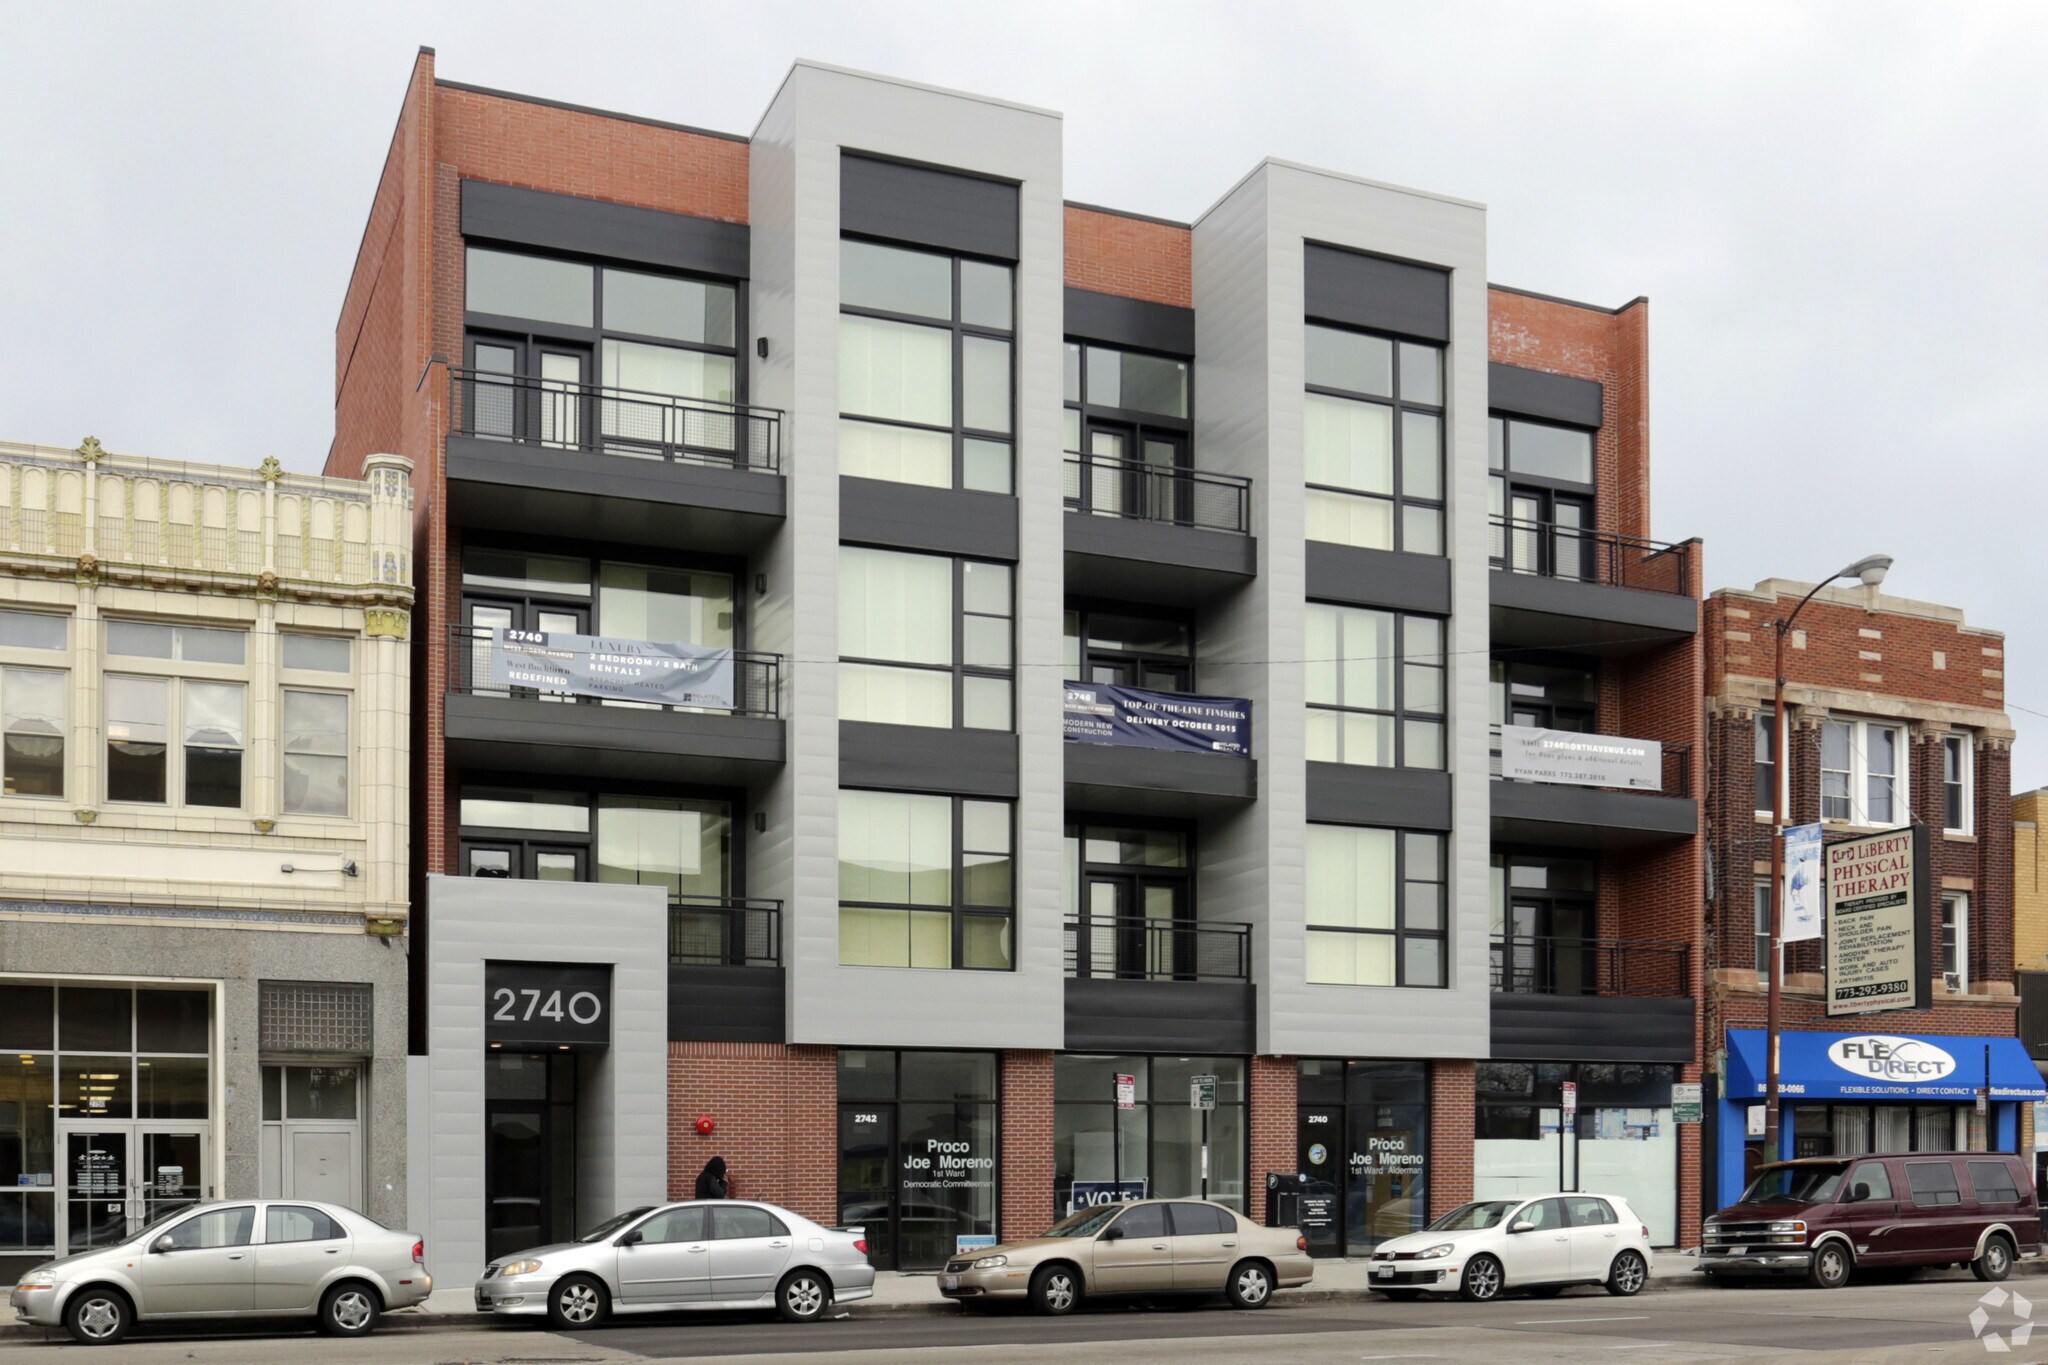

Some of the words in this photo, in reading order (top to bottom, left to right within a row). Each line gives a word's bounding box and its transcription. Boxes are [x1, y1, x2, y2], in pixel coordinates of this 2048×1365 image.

[509, 630, 543, 642] 2740
[547, 651, 574, 659] AVENUE
[600, 654, 652, 666] BEDROOM
[673, 662, 698, 671] BATH
[528, 663, 570, 674] Bucktown
[590, 664, 641, 676] RENTALS
[509, 671, 567, 685] REDEFINED
[589, 684, 624, 693] PARKING
[634, 682, 665, 690] HEATED
[1068, 692, 1091, 701] 2740
[1123, 700, 1203, 715] TOP-OF-THE-LINE
[1206, 708, 1245, 720] FINISHES
[1126, 715, 1170, 726] DELIVERY
[1172, 720, 1213, 730] OCTOBER
[1215, 724, 1237, 733] 2015
[1063, 726, 1113, 736] CONSTRUCTION
[1543, 740, 1645, 756] 2740NORTHAVENUE.COM
[1833, 872, 1910, 898] THERAPY
[1844, 899, 1864, 907] THERAPY
[1838, 917, 1856, 925] BACK
[1838, 928, 1873, 938] SHOULDER
[1861, 930, 1911, 942] REPLACEMENT
[1839, 939, 1893, 950] REHABILITATION
[1839, 949, 1870, 958] ANODYNE
[1873, 944, 1905, 953] THERAPY
[1839, 956, 1865, 964] CENTER
[1839, 969, 1862, 977] INJURY
[1839, 975, 1874, 984] ARTHRITIS
[1837, 982, 1907, 998] 773-292-9380
[494, 988, 601, 1024] 2740
[1833, 996, 1911, 1009] www.libertyphysical.com
[1840, 1086, 1870, 1094] FLEXIBLE
[1871, 1087, 1909, 1095] SOLUTIONS
[1916, 1087, 1939, 1095] DIRECT
[1940, 1087, 1970, 1095] CONTACT
[855, 1114, 878, 1123] 2742
[1308, 1116, 1328, 1124] 2740
[927, 1139, 970, 1152] Proco
[1369, 1137, 1405, 1150] Proco
[903, 1155, 931, 1169] Joe
[939, 1155, 993, 1169] Moreno
[1349, 1152, 1373, 1165] Joe
[1379, 1152, 1424, 1165] Moreno
[932, 1170, 943, 1178] 1st
[945, 1169, 966, 1178] Ward
[1363, 1166, 1384, 1174] Ward
[903, 1180, 941, 1188] Democratic
[943, 1180, 994, 1188] Committeeman
[1270, 1176, 1276, 1186] P
[1085, 1191, 1131, 1207] VOE
